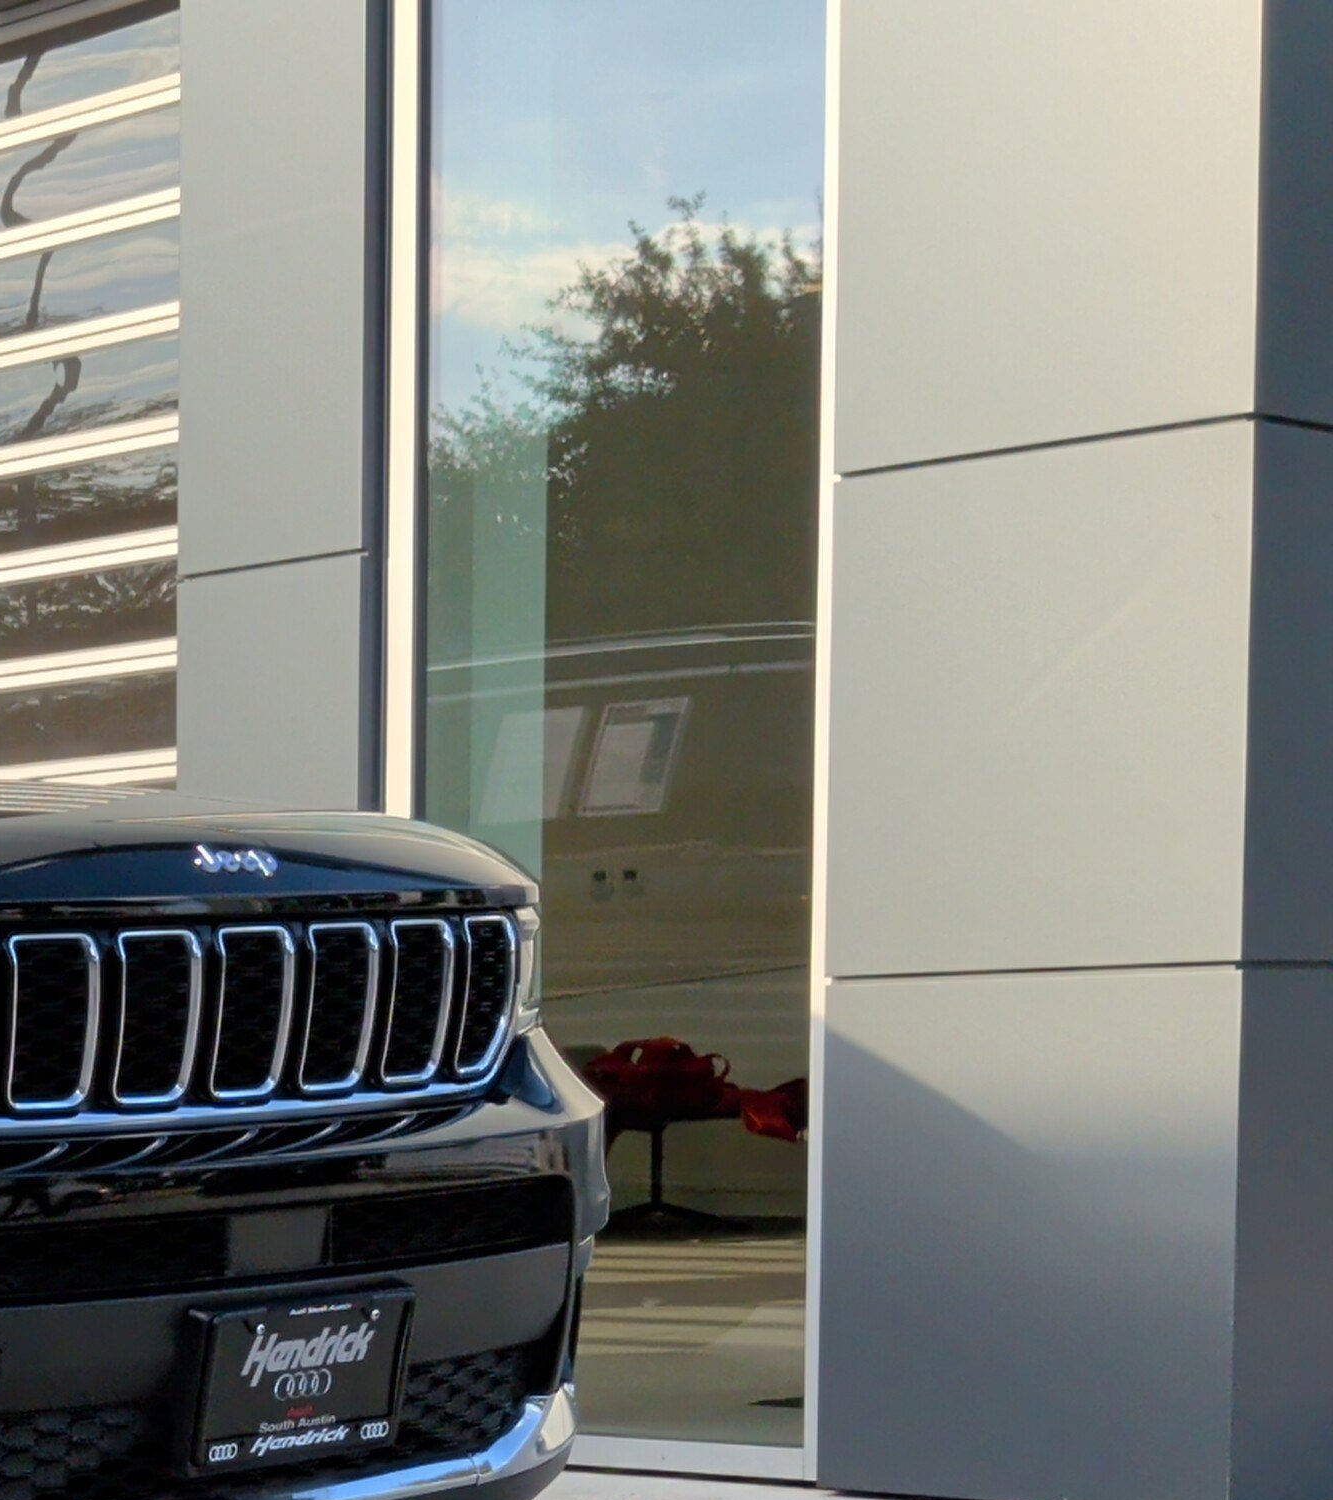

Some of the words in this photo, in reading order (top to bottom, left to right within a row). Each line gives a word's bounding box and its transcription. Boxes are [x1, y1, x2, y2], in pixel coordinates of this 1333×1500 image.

[194, 845, 278, 877] Jeep
[240, 1322, 375, 1387] Hendrick
[258, 1420, 295, 1433] South
[298, 1414, 336, 1428] Austin
[250, 1425, 349, 1457] Hendrick
